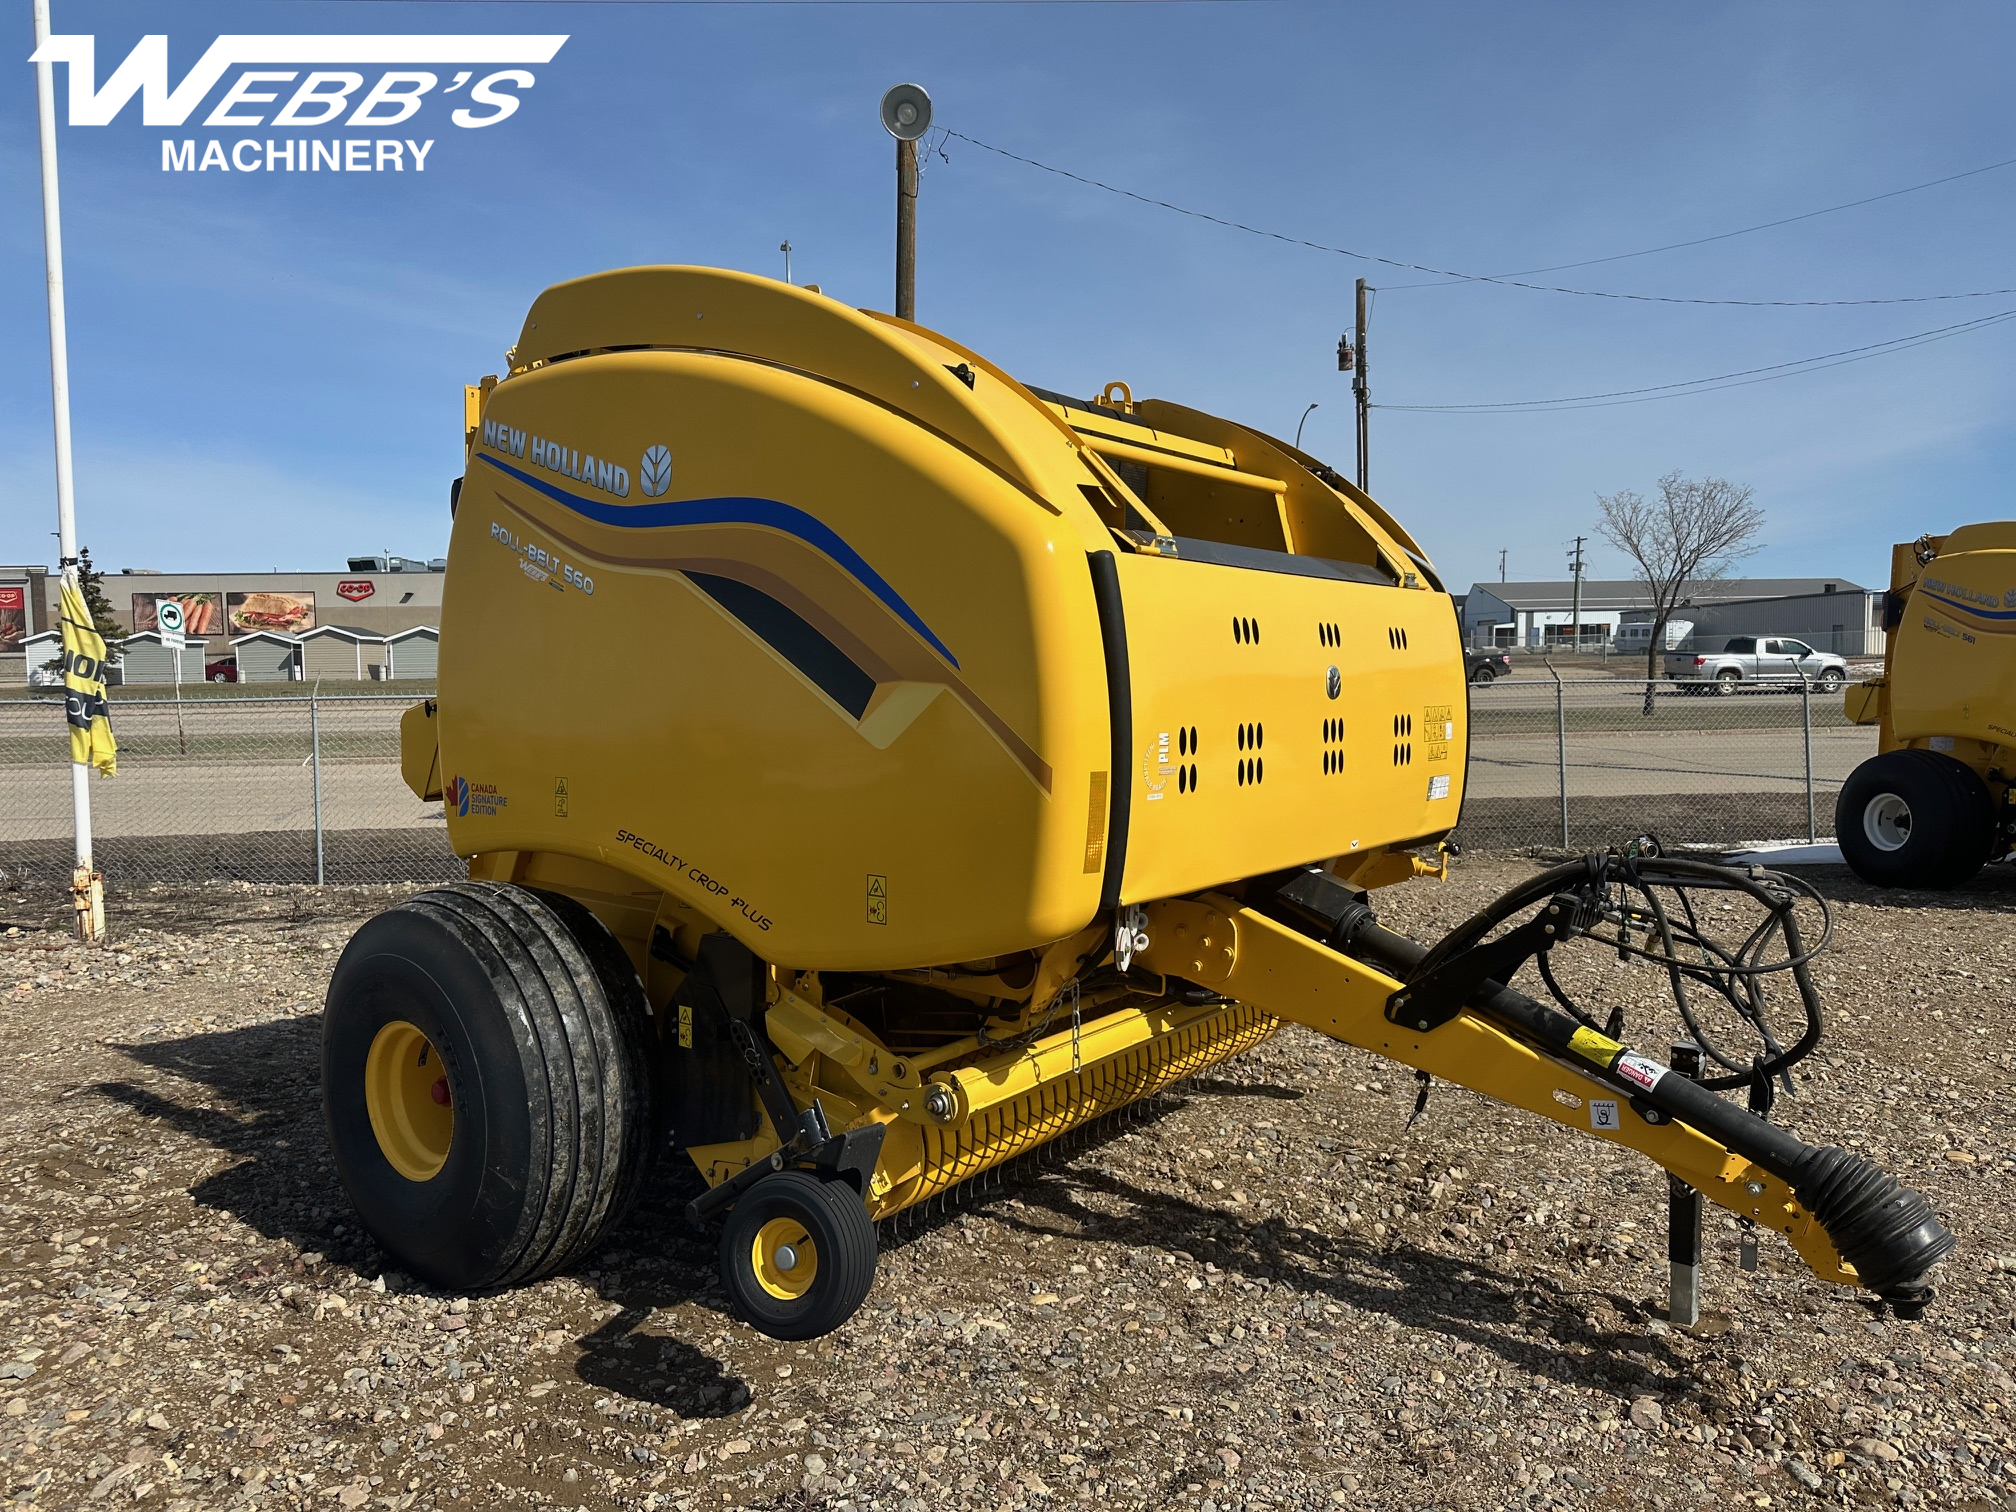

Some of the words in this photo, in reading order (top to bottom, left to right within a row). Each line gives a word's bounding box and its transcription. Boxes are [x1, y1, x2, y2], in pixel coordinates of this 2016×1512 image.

[482, 418, 527, 459] NEW
[531, 435, 630, 498] HOLLAND
[490, 521, 560, 575] ROLL-BELT
[563, 563, 594, 595] 560
[1923, 577, 1946, 593] NEW
[1946, 584, 1999, 608] HOLLAND
[1962, 633, 1976, 645] 561
[1158, 732, 1169, 763] PLM
[471, 782, 497, 794] CANADA
[471, 793, 508, 807] SIGNATURE
[471, 804, 497, 816] EDITION
[616, 829, 688, 871] SPECIALTY
[688, 868, 729, 896] CROP
[1621, 1064, 1645, 1081] DANGER
